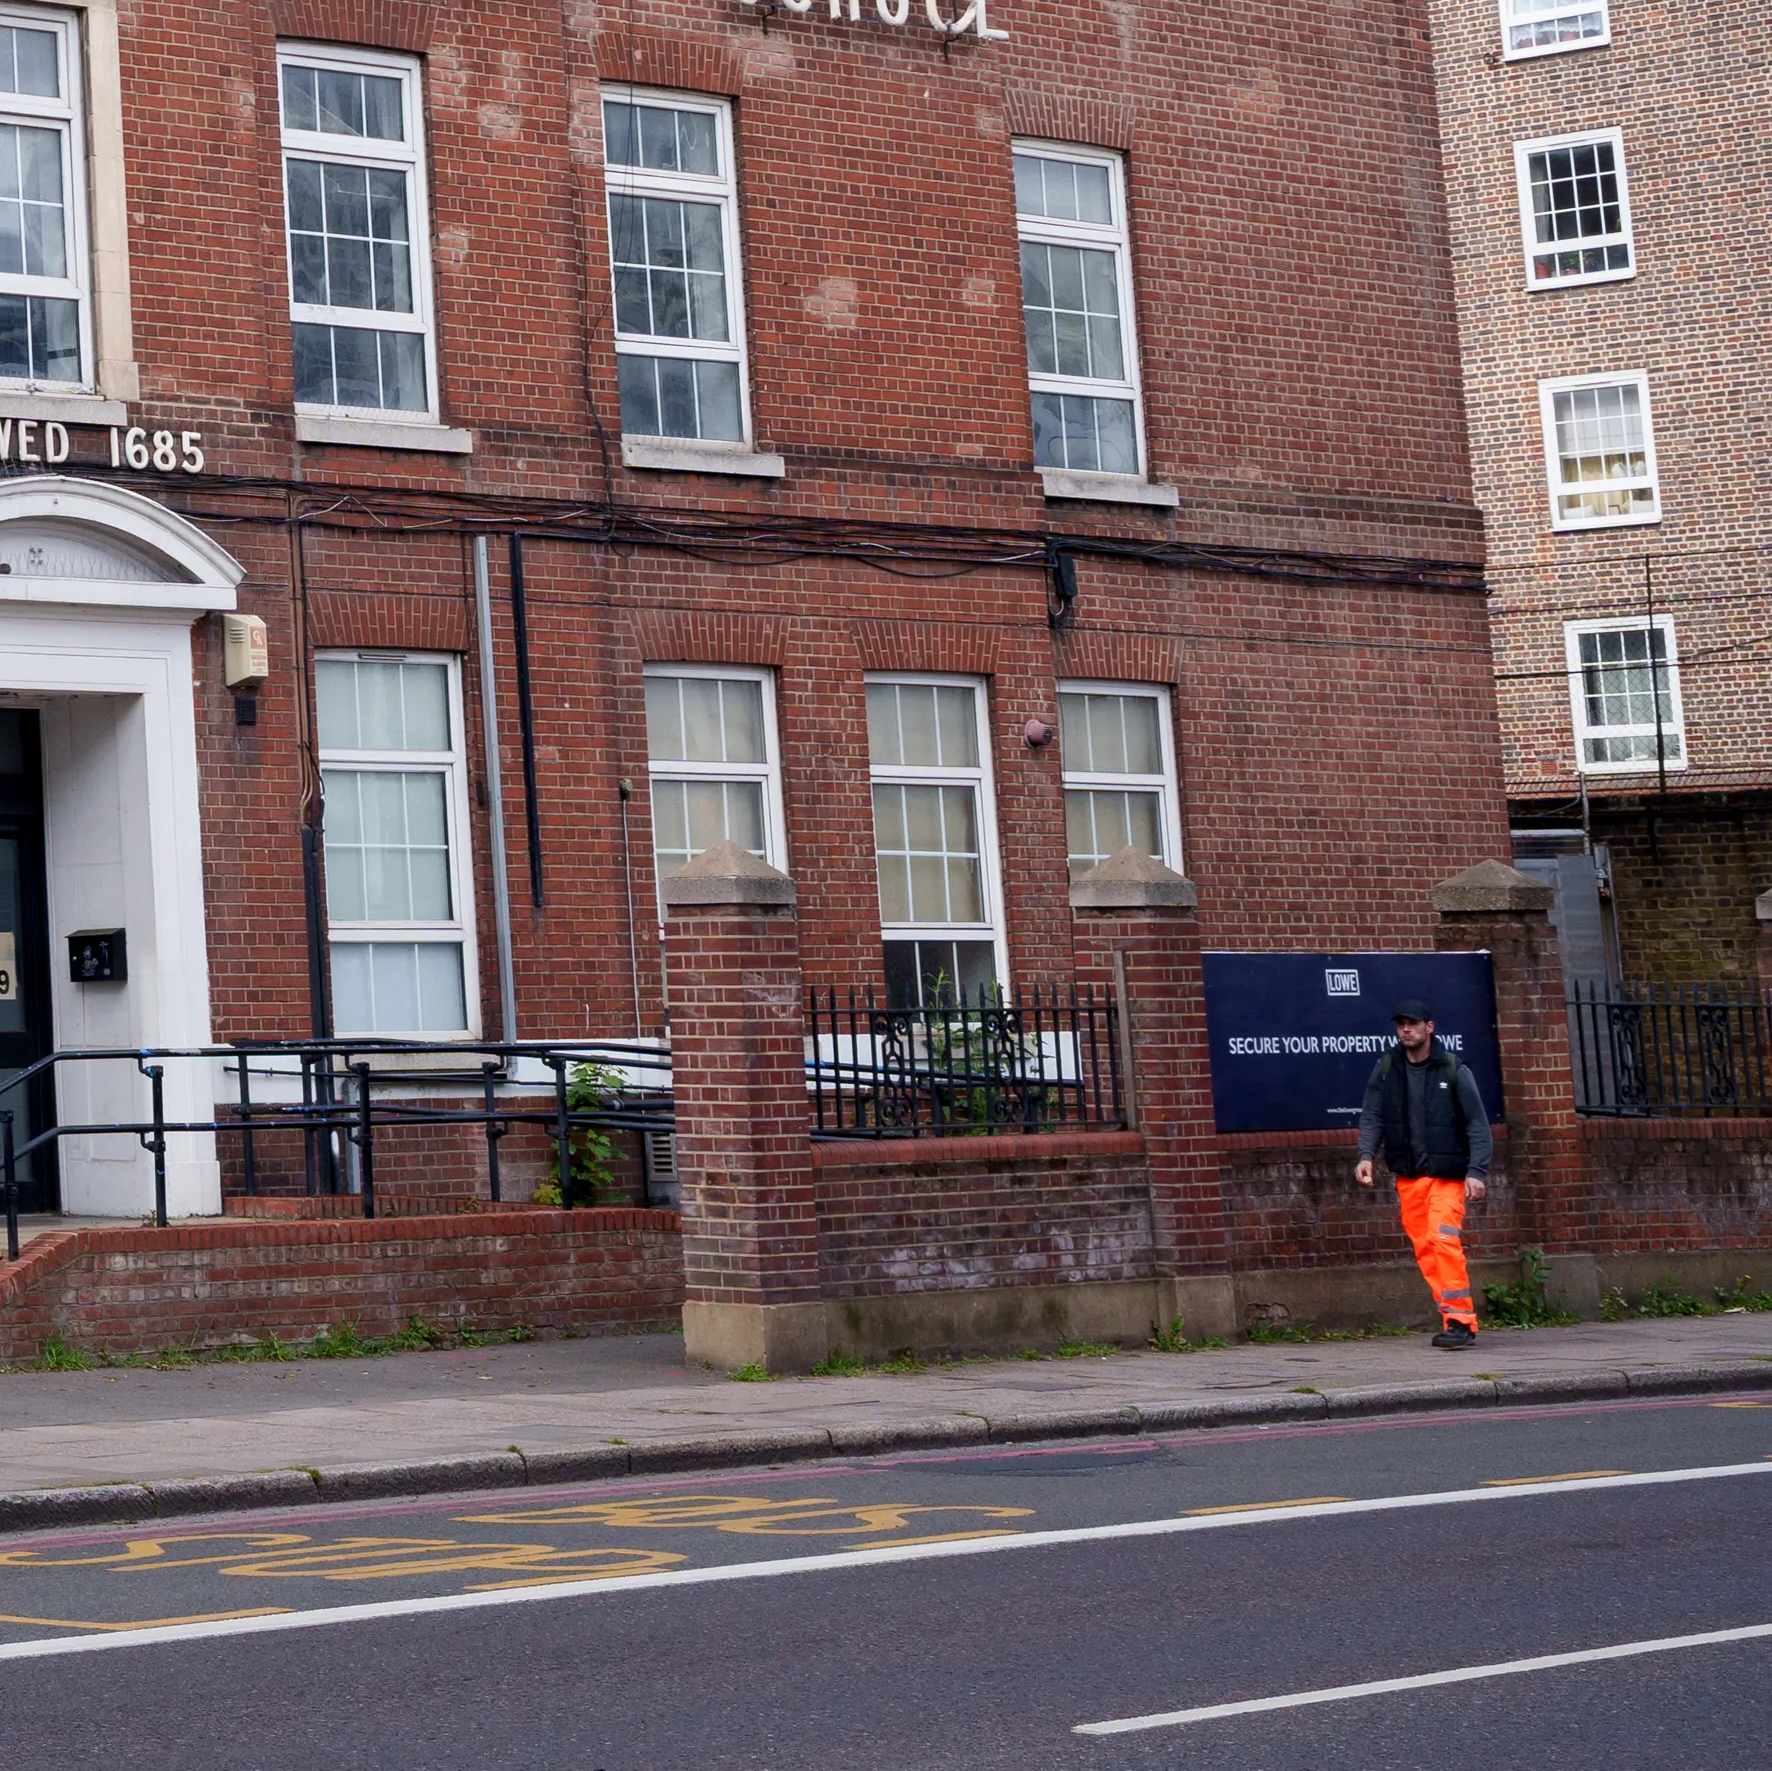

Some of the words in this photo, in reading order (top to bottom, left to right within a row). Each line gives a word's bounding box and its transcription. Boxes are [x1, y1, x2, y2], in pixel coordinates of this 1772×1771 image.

[110, 426, 204, 473] 1685
[1328, 974, 1357, 991] LOWE
[1229, 1037, 1280, 1054] SECURE
[1281, 1036, 1320, 1054] YOUR
[1322, 1035, 1387, 1053] PROPERTY
[451, 1494, 1037, 1536] BUS
